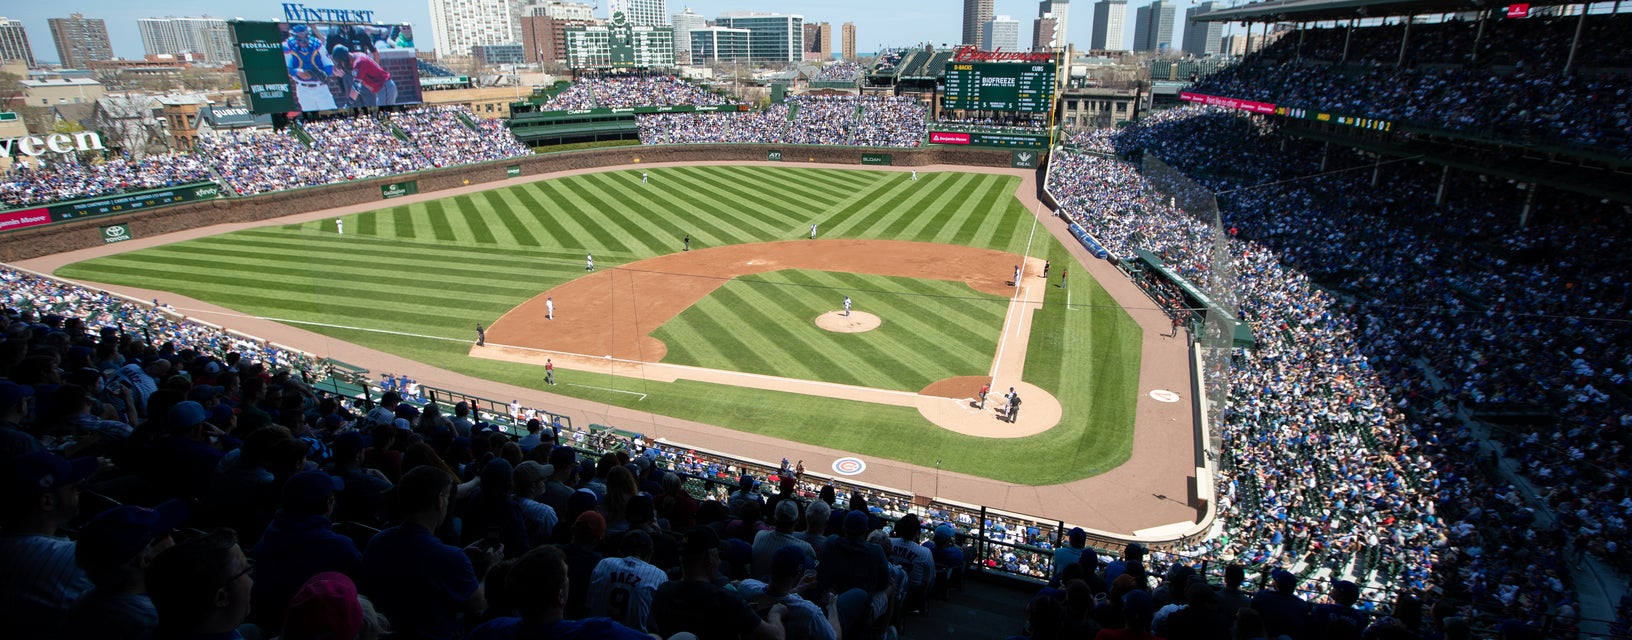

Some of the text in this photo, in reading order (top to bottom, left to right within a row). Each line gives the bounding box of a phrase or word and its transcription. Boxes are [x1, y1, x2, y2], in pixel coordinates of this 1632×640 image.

[282, 3, 375, 23] WINTRUST
[953, 44, 1051, 62] Budweiser
[195, 188, 218, 198] xfinity
[20, 215, 47, 223] Moore
[105, 234, 130, 243] TOYOTA
